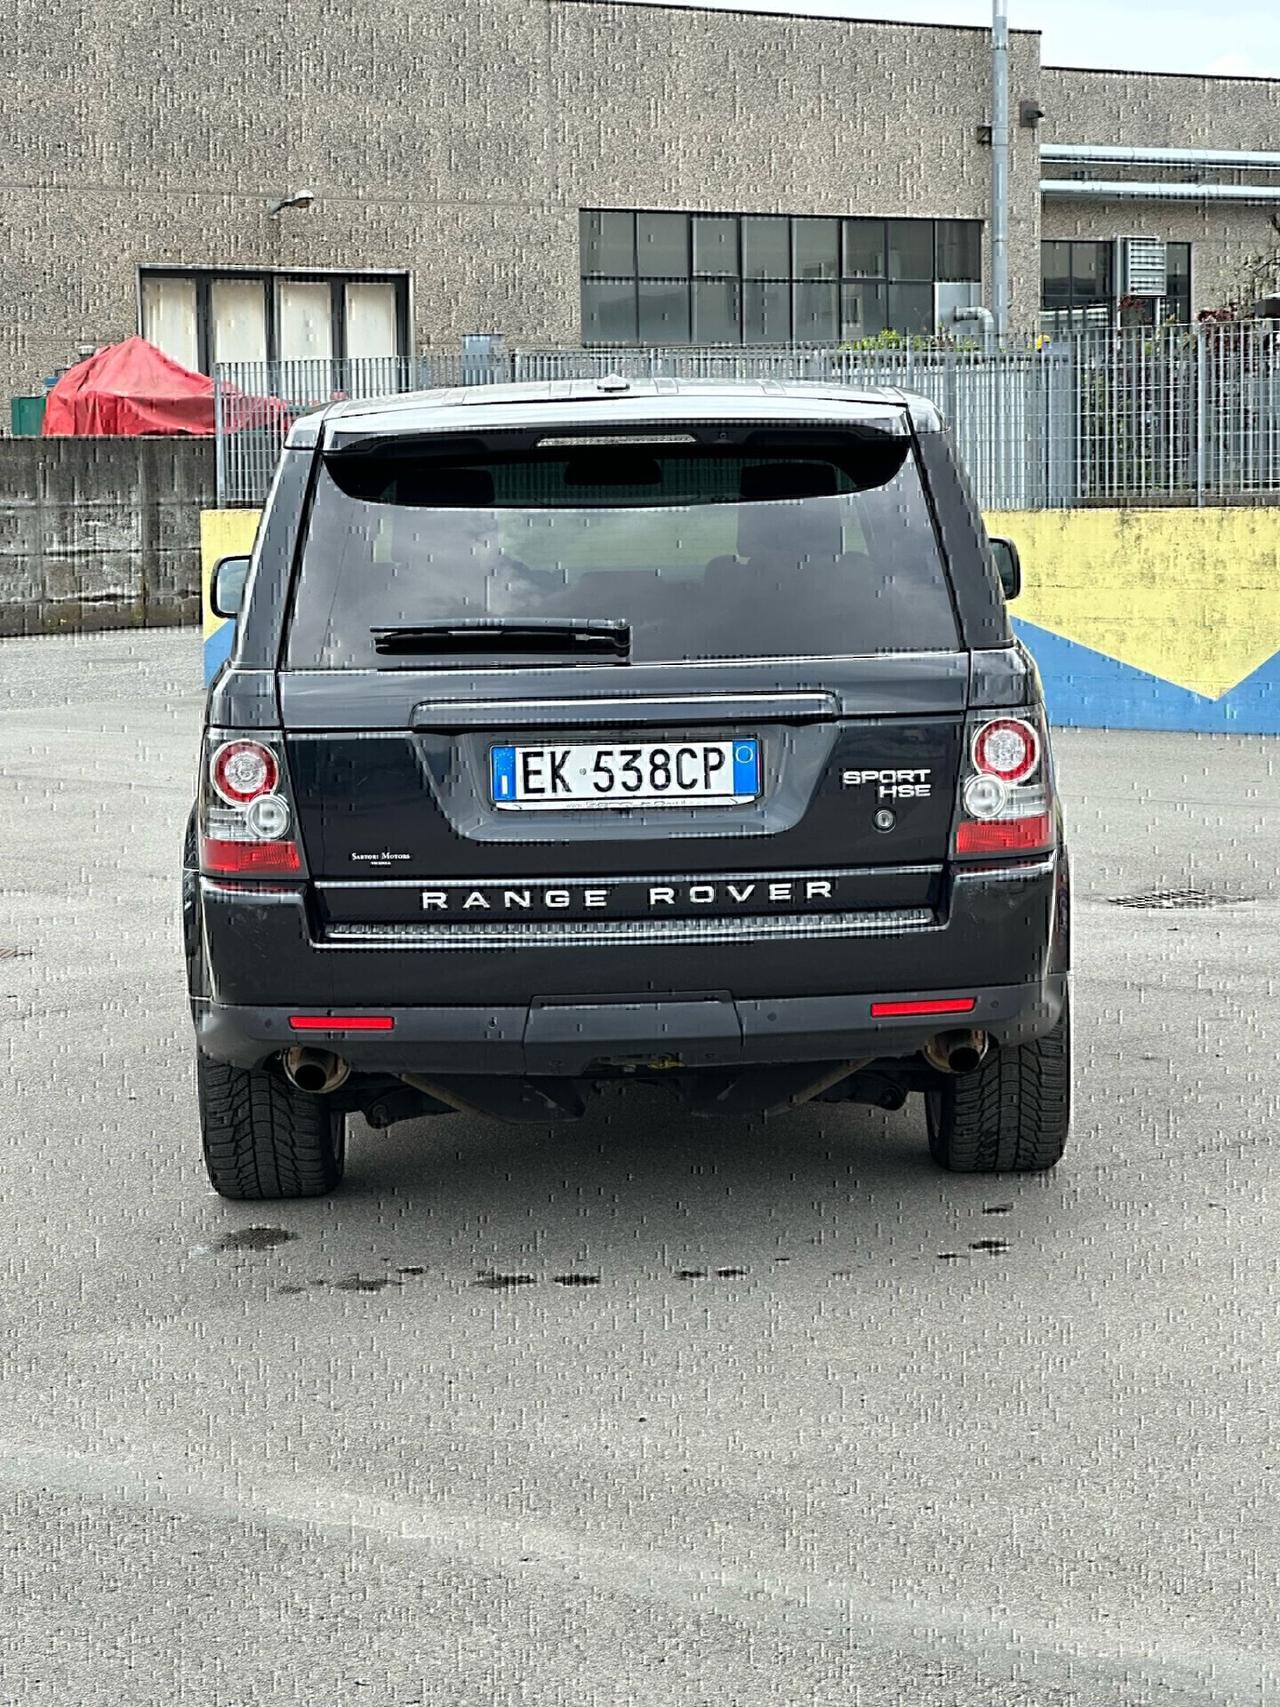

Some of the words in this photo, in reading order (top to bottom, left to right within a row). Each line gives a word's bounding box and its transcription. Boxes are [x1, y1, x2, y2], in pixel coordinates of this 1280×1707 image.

[522, 750, 572, 794] EK
[593, 747, 726, 793] 538CP
[843, 768, 931, 785] SPORT
[879, 784, 931, 798] HSE
[421, 889, 608, 909] RANGE
[649, 881, 833, 905] ROVER
